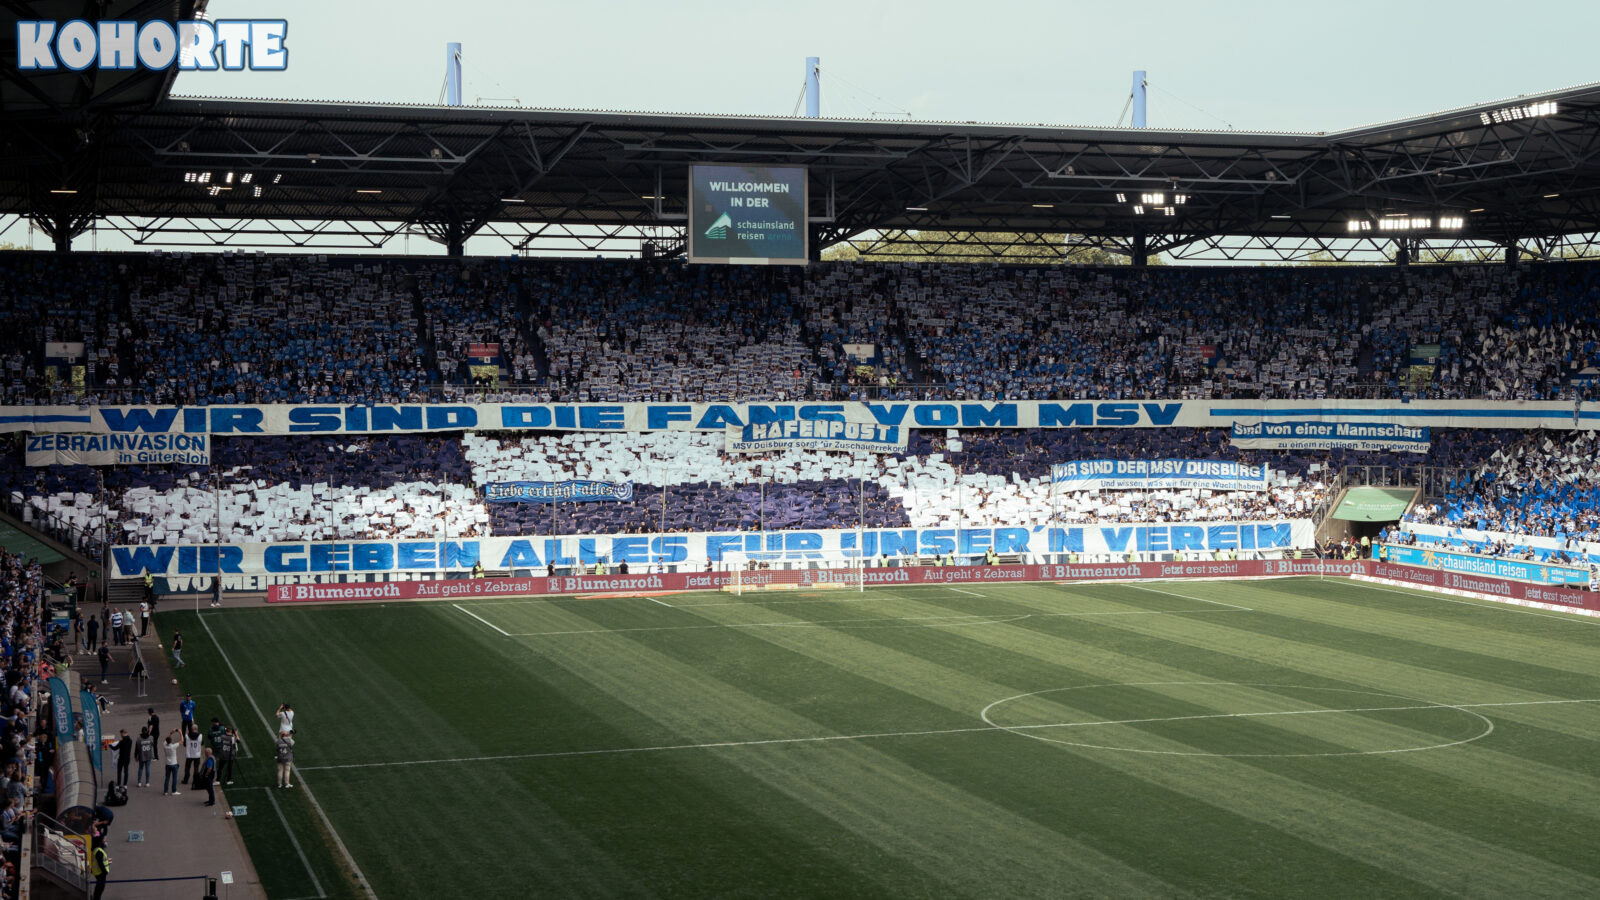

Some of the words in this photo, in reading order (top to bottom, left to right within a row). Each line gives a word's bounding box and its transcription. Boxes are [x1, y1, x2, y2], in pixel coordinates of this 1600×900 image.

[709, 181, 789, 193] WILLKOMMEN
[730, 197, 743, 207] IN
[746, 198, 769, 208] DER
[737, 220, 795, 230] schauinsland
[737, 231, 765, 240] reisen
[99, 407, 264, 432] WIR
[289, 406, 478, 432] SIND
[501, 406, 624, 429] DIE
[647, 405, 844, 429] FANS
[869, 403, 1018, 427] VOM
[1038, 403, 1182, 426] MSV
[752, 420, 891, 441] HAFENPOST
[1234, 424, 1262, 435] Sind
[1265, 425, 1292, 435] von
[1295, 423, 1333, 435] einer
[1336, 424, 1422, 438] Mannschaft
[27, 433, 206, 452] ZEBRAINVASION
[733, 442, 752, 450] MSV
[754, 440, 793, 450] Duisburg
[795, 440, 817, 449] sorgt
[1318, 441, 1358, 450] richtigen
[1361, 442, 1385, 450] Team
[1387, 443, 1430, 452] geworden
[119, 452, 133, 463] in
[137, 451, 209, 465] Gütersloh
[1054, 463, 1077, 478] WIR
[1080, 461, 1113, 475] SIND
[1117, 461, 1147, 474] DER
[1150, 461, 1182, 474] MSV
[1186, 462, 1260, 477] DUISBURG
[487, 483, 523, 499] Liebe
[528, 482, 577, 498] erträgt
[582, 482, 614, 496] alles
[112, 546, 244, 575] WIR
[264, 541, 480, 572] GEBEN
[500, 536, 688, 567] ALLES
[1100, 523, 1292, 552] VEREIN
[923, 568, 944, 580] Auf
[983, 567, 1026, 579] Zebras!
[1055, 564, 1141, 578] Blumenroth
[1161, 564, 1184, 576] Jetzt
[1186, 565, 1205, 574] erst
[1208, 563, 1238, 574] recht!
[1278, 561, 1366, 574] Blumenroth
[1375, 565, 1387, 576] Auf
[1498, 563, 1528, 578] reisen
[565, 574, 663, 591] Blumenroth
[685, 575, 711, 589] Jetzt
[713, 575, 736, 586] erst
[818, 569, 909, 583] Blumenroth
[296, 583, 401, 599] Blumenroth
[417, 584, 439, 596] Auf
[484, 580, 532, 593] Zebras!
[1452, 575, 1511, 595] Blumenroth
[1525, 586, 1541, 599] Jetzt
[1543, 592, 1558, 601] erst
[1560, 594, 1583, 605] recht!
